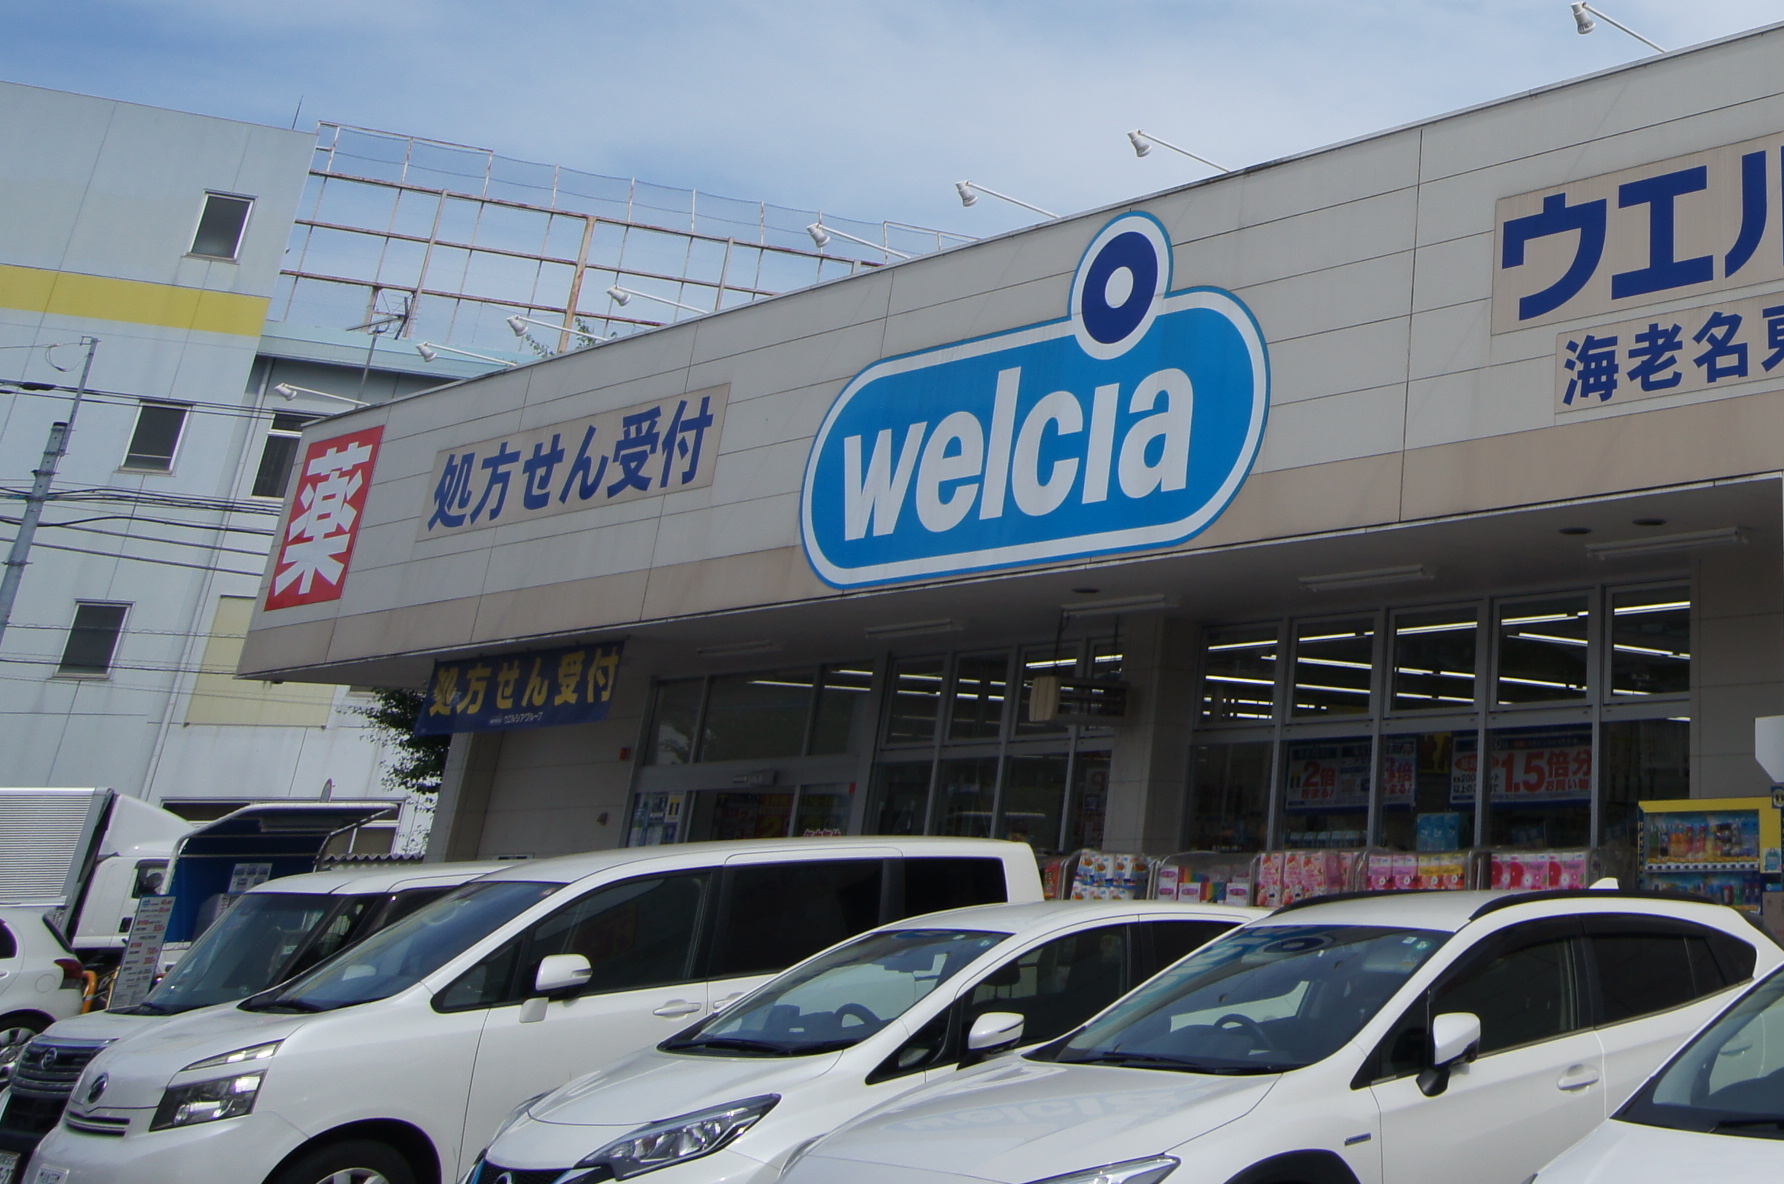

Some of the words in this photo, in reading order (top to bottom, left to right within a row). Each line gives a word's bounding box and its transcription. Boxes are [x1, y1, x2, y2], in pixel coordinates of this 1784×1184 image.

[274, 441, 373, 597] 薬
[427, 396, 714, 531] 処方せん受付
[843, 367, 1194, 541] welcia
[429, 646, 619, 717] 処方せん受付
